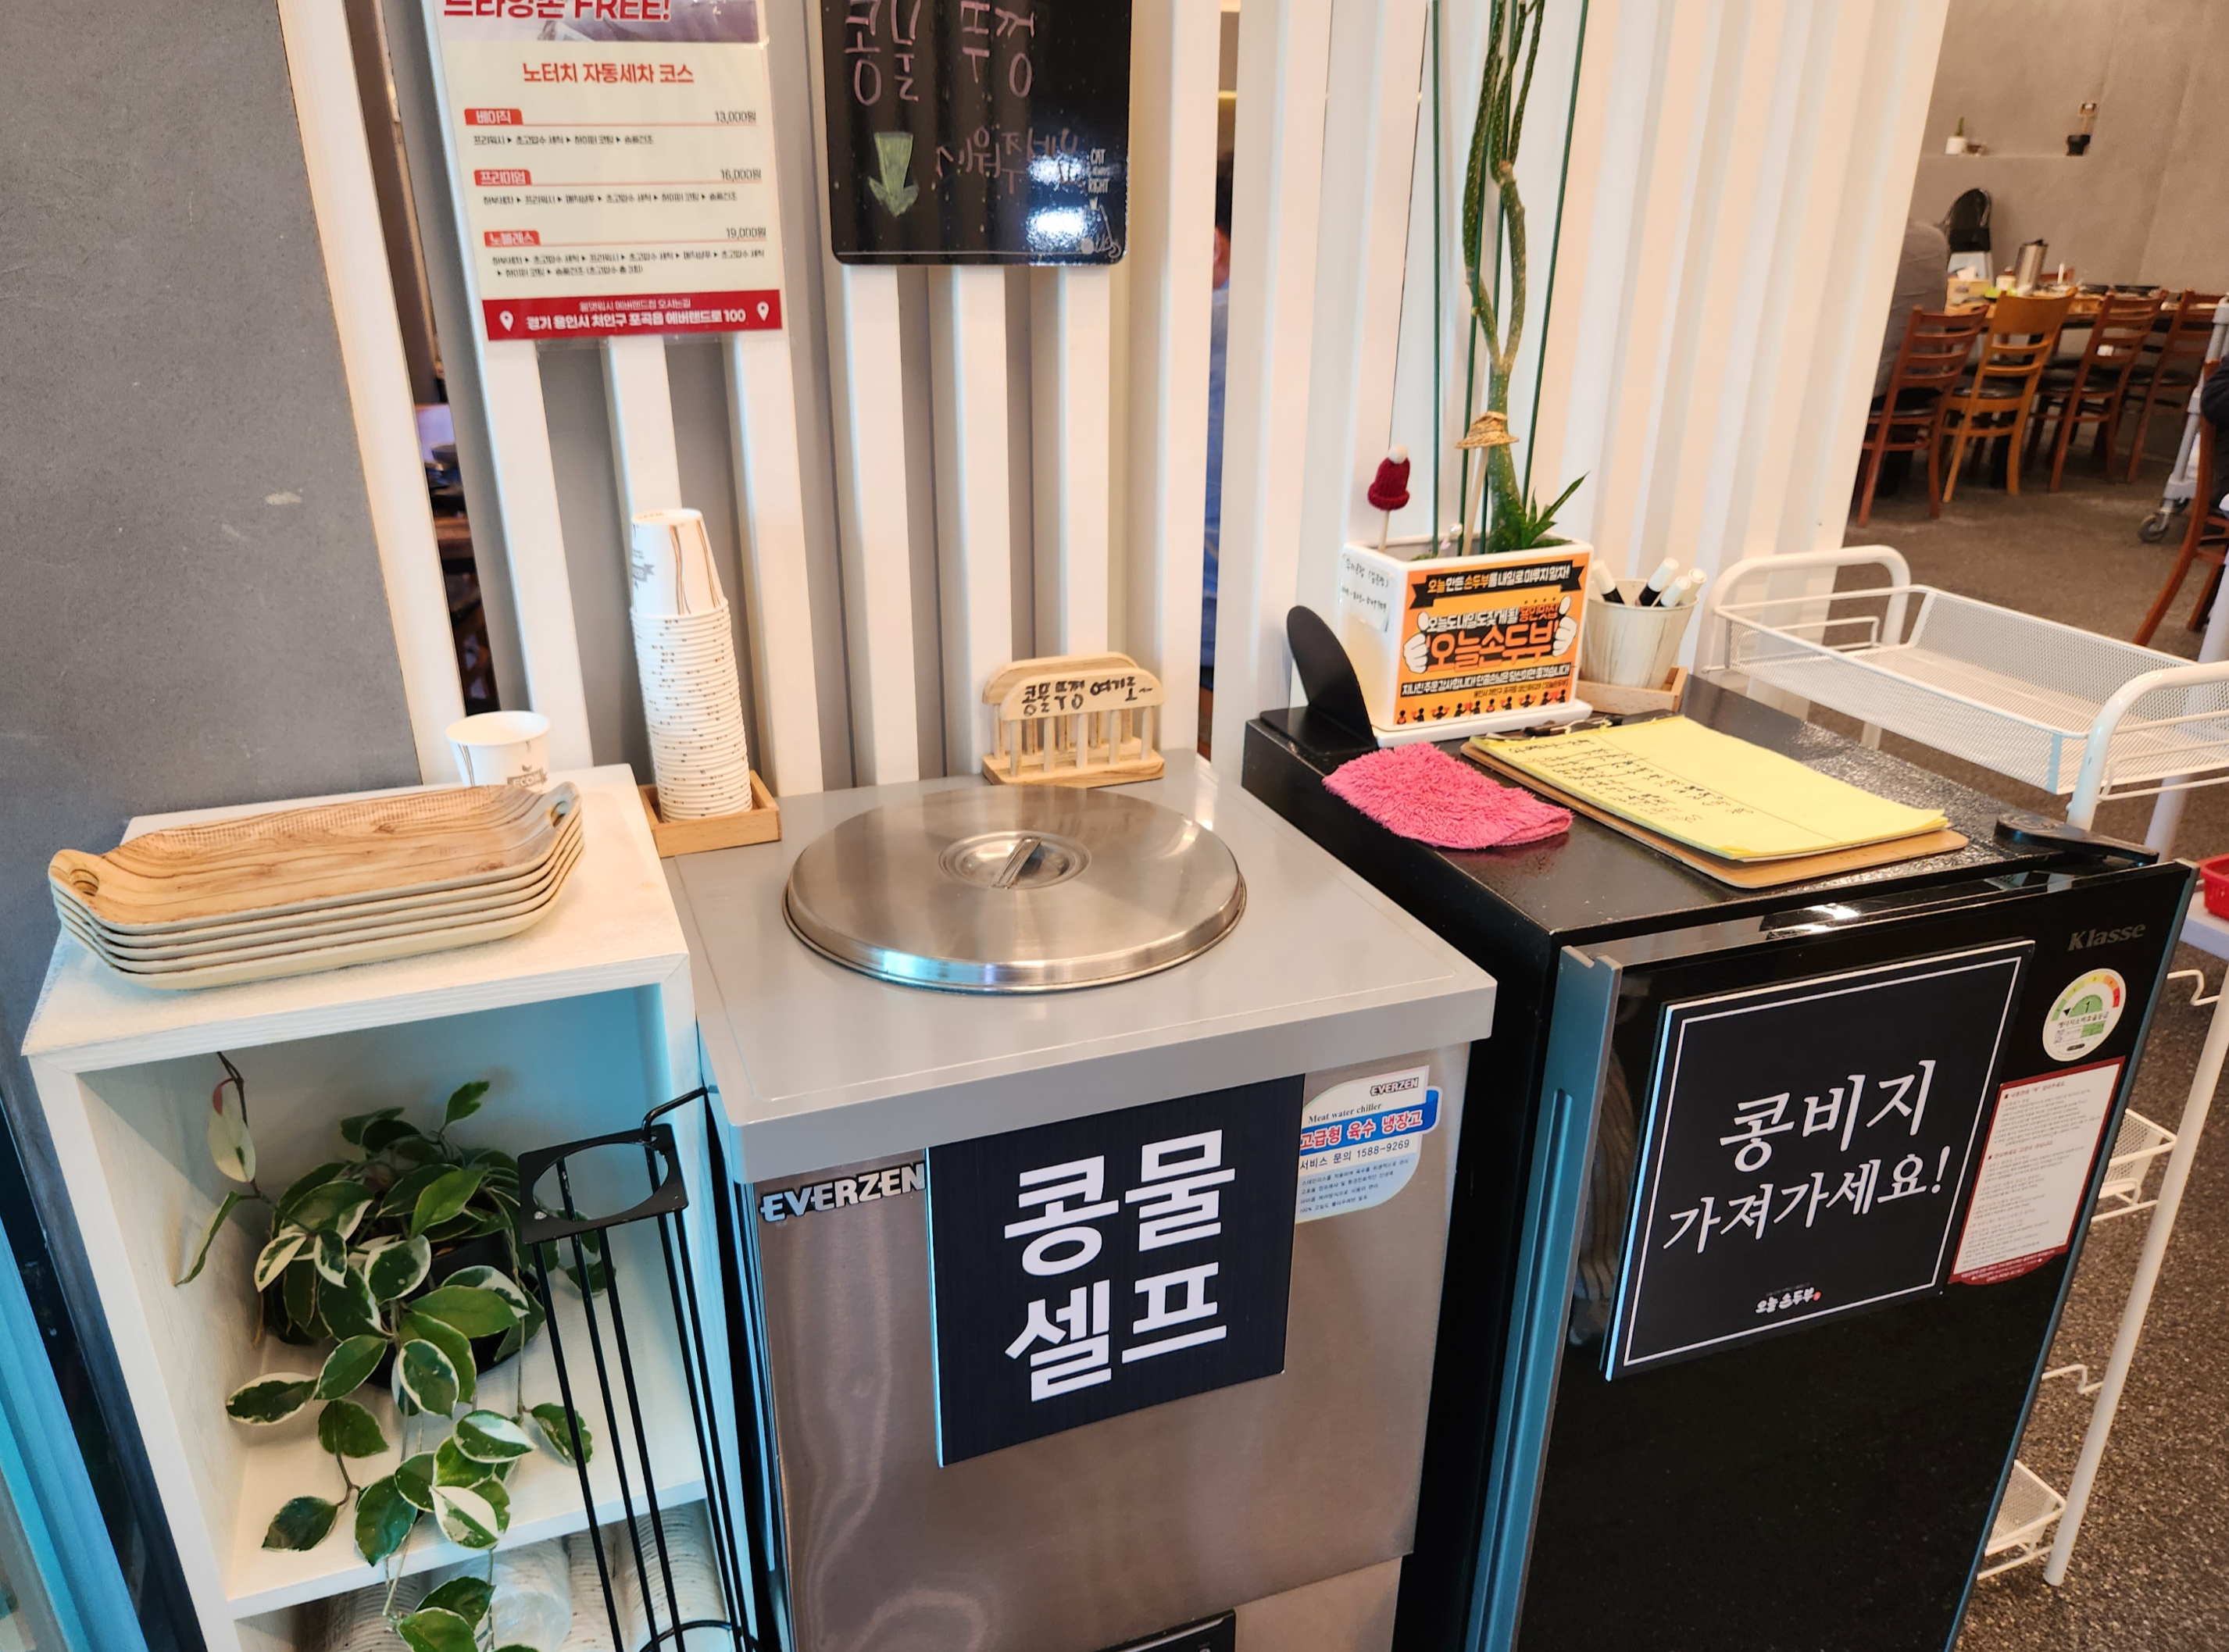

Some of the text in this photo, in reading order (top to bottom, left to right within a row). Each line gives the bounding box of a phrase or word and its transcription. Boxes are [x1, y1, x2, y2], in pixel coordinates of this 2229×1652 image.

[574, 0, 671, 20] FREE!
[523, 62, 695, 84] 노터치 자동세차 코스
[475, 109, 512, 124] 베이직
[715, 111, 756, 123] 13,000원
[479, 170, 526, 185] 프리미엄
[720, 168, 762, 182] 16,000원
[489, 233, 536, 246] 노블레스
[726, 227, 766, 240] 19,000원
[658, 298, 691, 309] 오시는길
[526, 309, 746, 330] 경기 용인시 처인구 포곡읍 에버랜드로 100
[1427, 564, 1570, 594] 오늘 만든 손두부를 내일로 미루지 말자!
[1402, 682, 1424, 695] 지나친
[1423, 680, 1438, 693] 주문
[1438, 676, 1476, 692] 감사합니다!
[1021, 683, 1051, 716] 콩물
[1054, 680, 1085, 710] 뚜껑
[2067, 923, 2145, 952] Klasse
[1370, 1076, 1420, 1097] EVERZEN
[1308, 1102, 1382, 1124] Meat water chiller
[1719, 1059, 1936, 1173] 콩비지
[1300, 1109, 1423, 1149] 고급형 육수 냉장고
[1299, 1139, 1410, 1170] 서비스 문의 1588-9269
[760, 1162, 926, 1223] EVERZEN
[1004, 1129, 1236, 1276] 콩물
[1663, 1145, 1951, 1254] 가져가세요!
[1755, 1296, 1779, 1314] 오늘
[1004, 1261, 1227, 1402] 셀프
